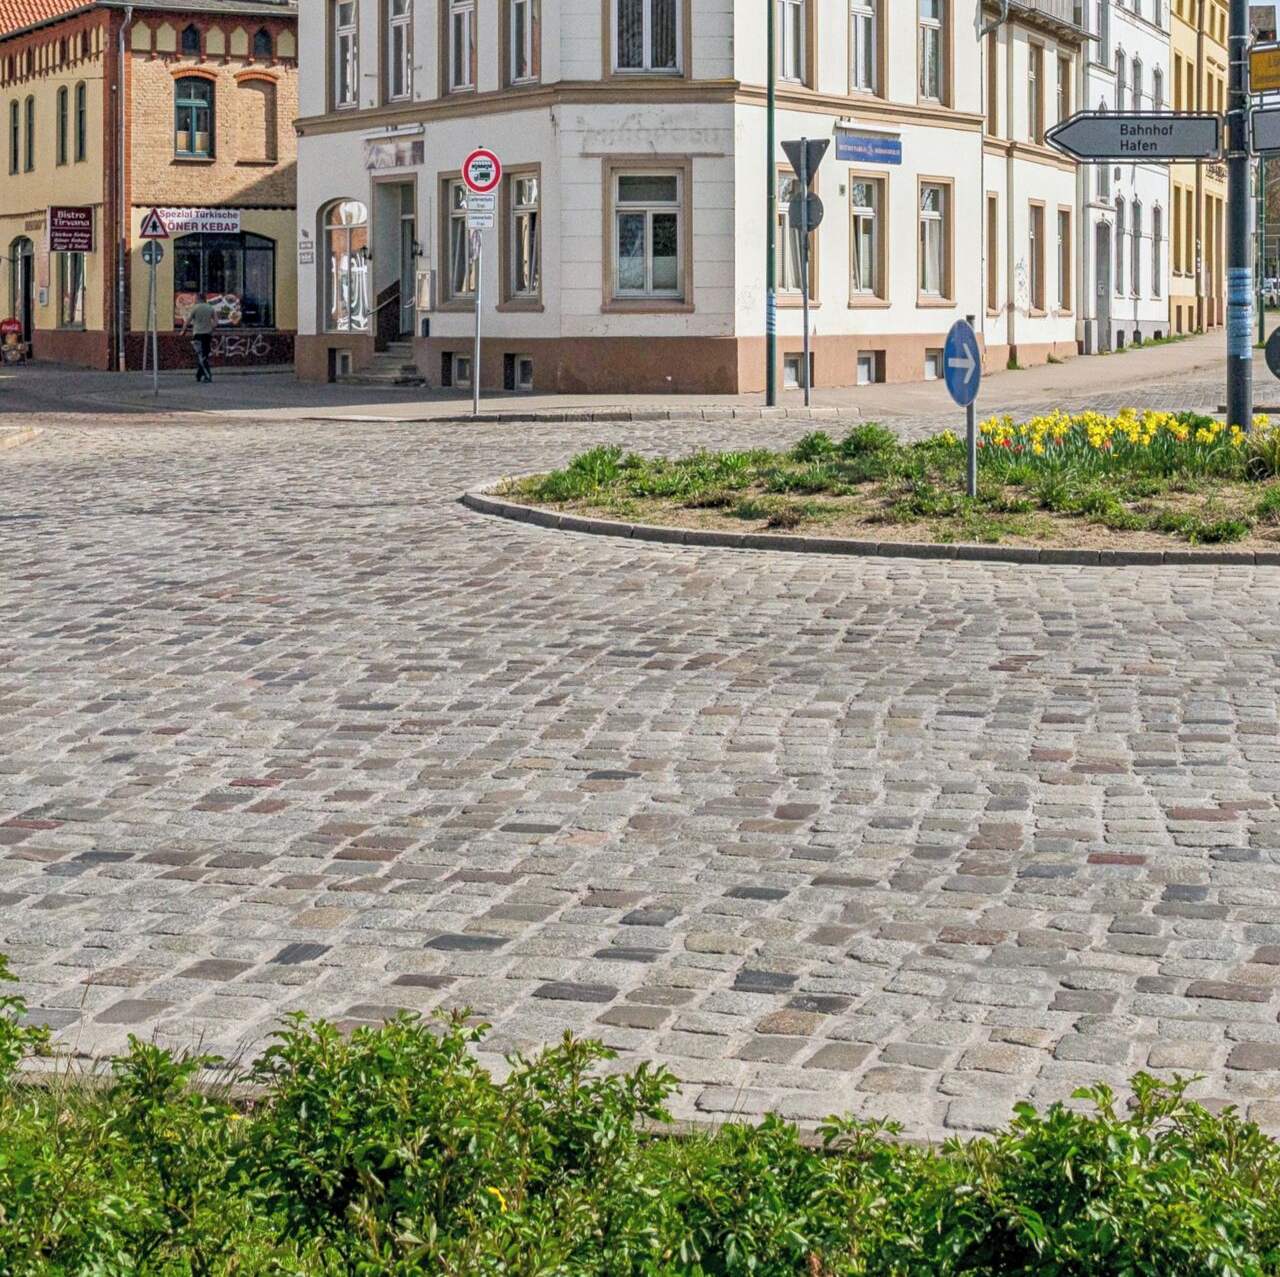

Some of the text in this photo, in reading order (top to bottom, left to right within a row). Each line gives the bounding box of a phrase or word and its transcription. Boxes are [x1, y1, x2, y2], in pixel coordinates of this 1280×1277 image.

[1120, 124, 1173, 136] Bahnhof
[1120, 140, 1158, 152] Hafen
[57, 210, 86, 219] Bistro
[160, 209, 238, 219] Spezial Türkische
[53, 218, 90, 226] Tirvana
[201, 222, 238, 232] KEBAP
